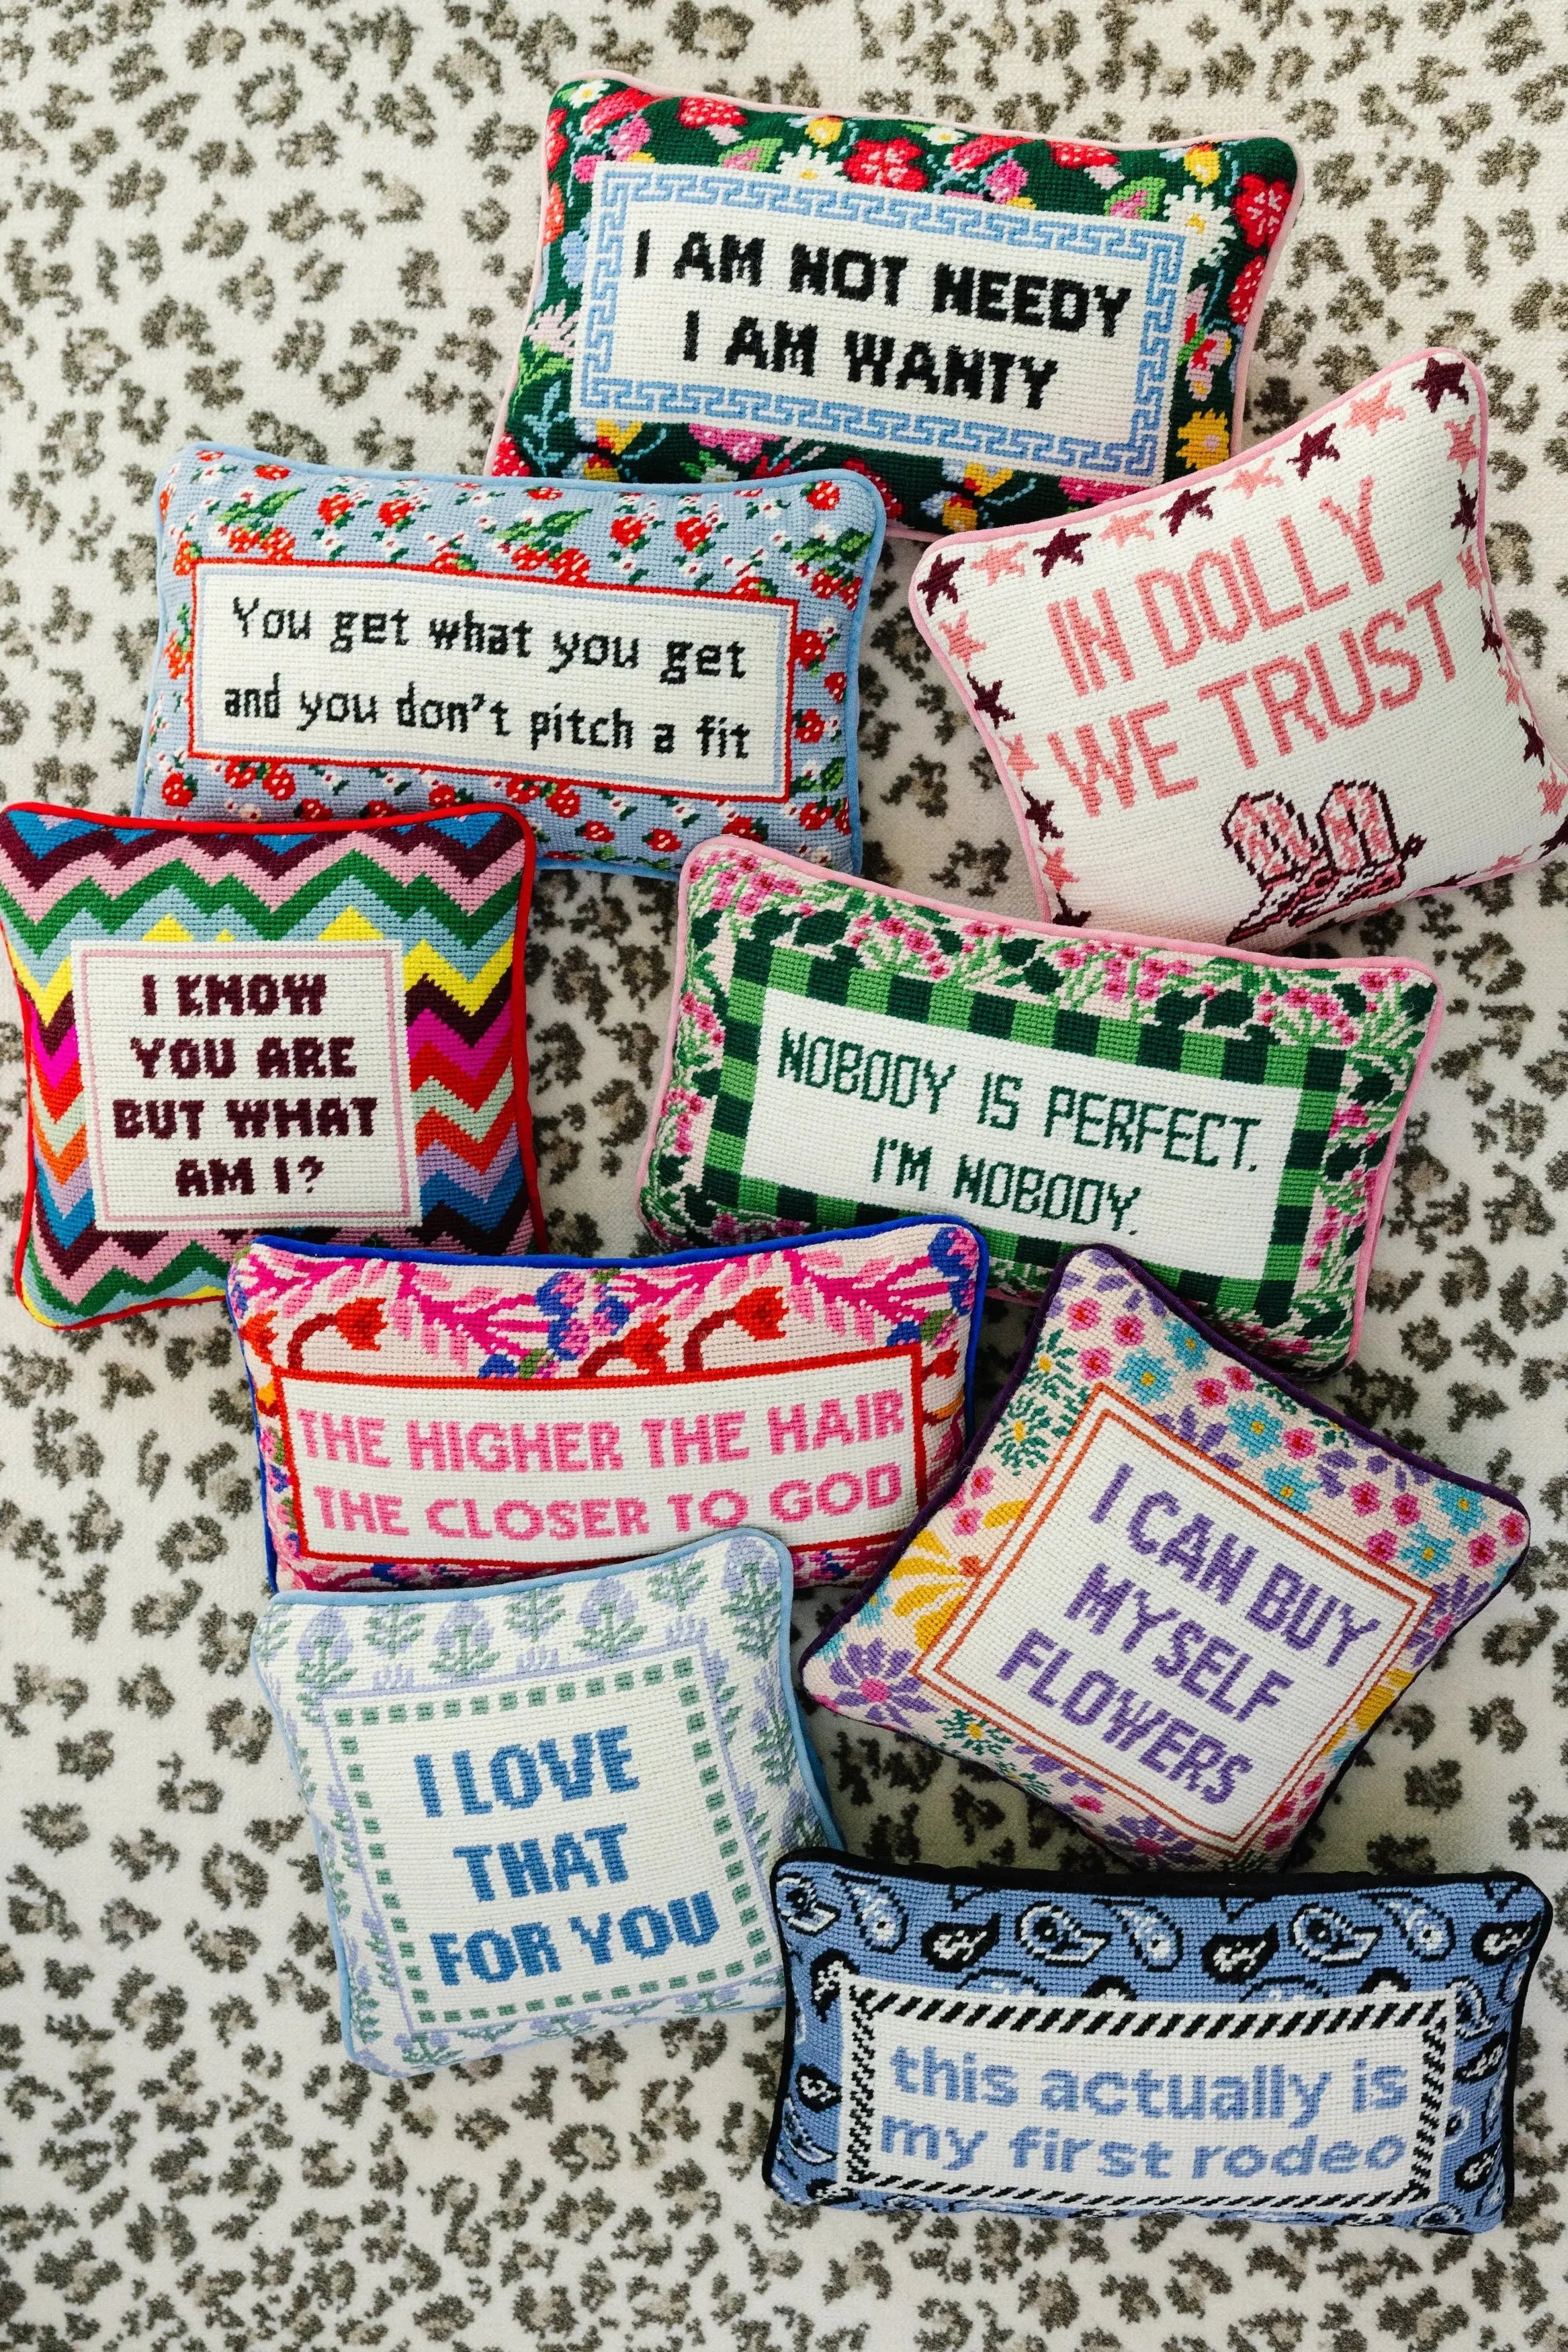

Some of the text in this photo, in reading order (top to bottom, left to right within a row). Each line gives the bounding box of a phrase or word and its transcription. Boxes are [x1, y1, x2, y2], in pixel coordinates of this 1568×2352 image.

[634, 229, 1132, 337] I AM NOT NEEDY
[682, 310, 1059, 409] I AM WANTY
[1047, 475, 1385, 697] IN DOLLY
[232, 597, 747, 684] You get what you get
[224, 674, 750, 759] and you don't pitch a fit
[1047, 582, 1456, 818] WE TRUST
[142, 974, 326, 1016] I KNOW
[130, 1037, 357, 1079] YOU ARE
[778, 1027, 1264, 1173] NOBODY IS PERFECT.
[112, 1097, 378, 1139] BUT WHAT
[174, 1155, 324, 1198] AM I?
[872, 1136, 1142, 1236] I'M NOBODY.
[296, 1389, 905, 1474] THE HIGHER THE HAIR
[313, 1462, 902, 1541] THE CLOSER TO GOD
[1089, 1463, 1380, 1669] I CAN BUY
[1063, 1563, 1294, 1722] MYSELF
[996, 1628, 1254, 1804] FLOWERS
[414, 1725, 640, 1817] I LOVE
[453, 1823, 629, 1902] THAT
[429, 1890, 721, 1986] FOR YOU
[889, 2046, 1409, 2129] this actually is
[880, 2113, 1409, 2179] my first rodeo
